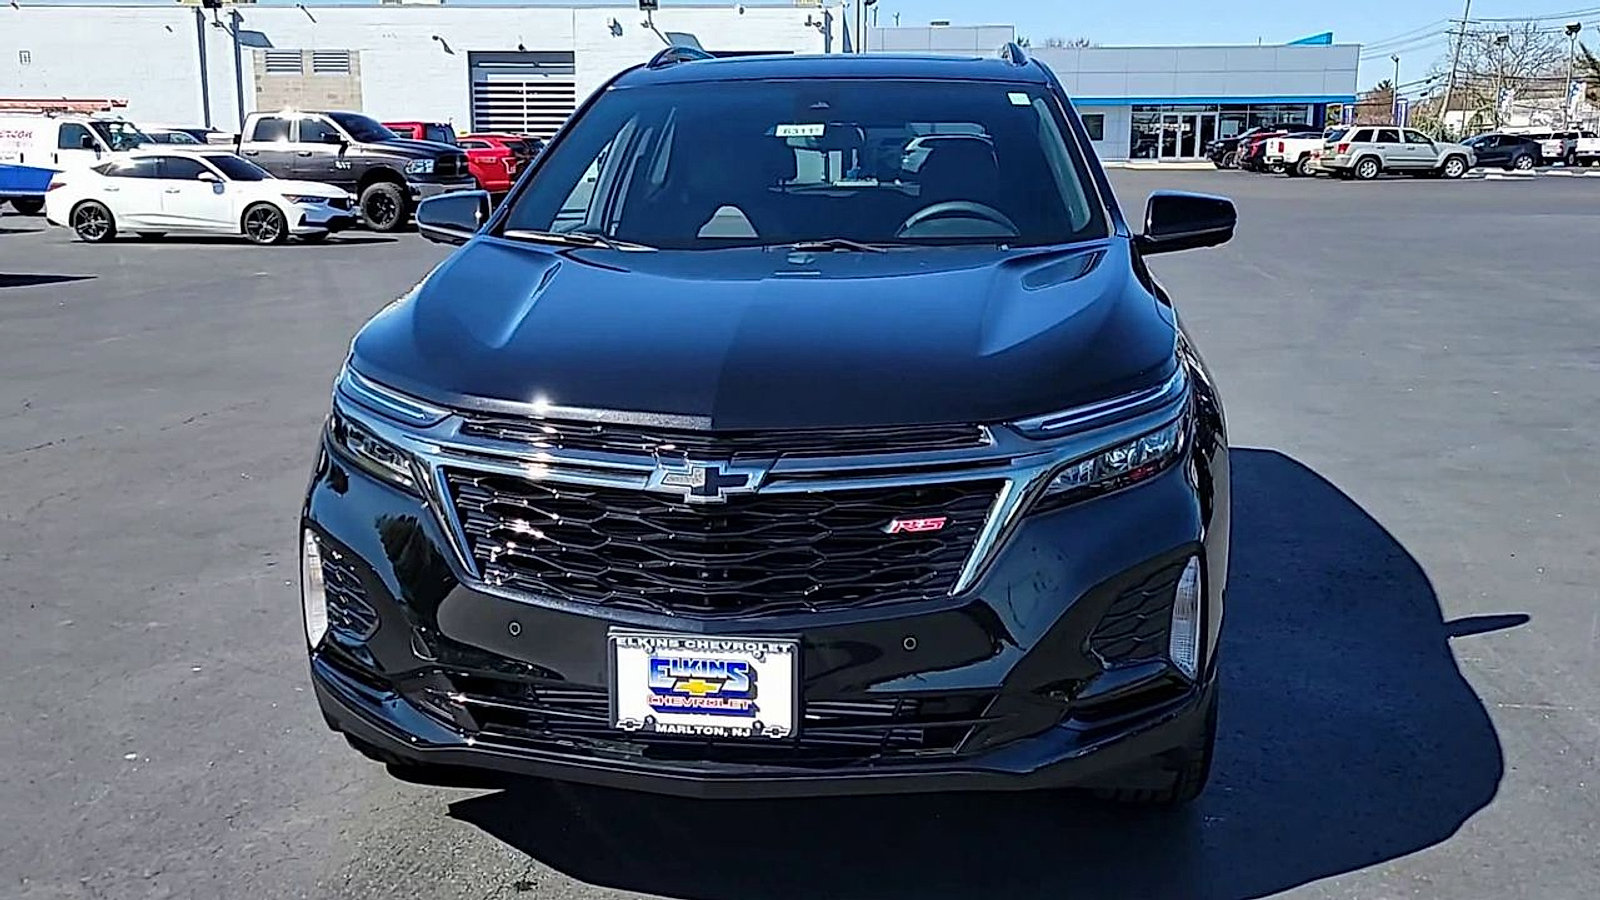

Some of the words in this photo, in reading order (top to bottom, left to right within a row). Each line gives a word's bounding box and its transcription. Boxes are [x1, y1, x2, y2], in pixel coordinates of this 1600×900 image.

[887, 517, 947, 533] RS
[617, 637, 682, 649] ELKINS
[684, 641, 791, 653] CHEVROLET
[648, 657, 750, 691] ELKINS
[647, 694, 751, 710] CHEVROLET
[655, 724, 728, 737] MARLTON,
[732, 728, 750, 737] NJ
